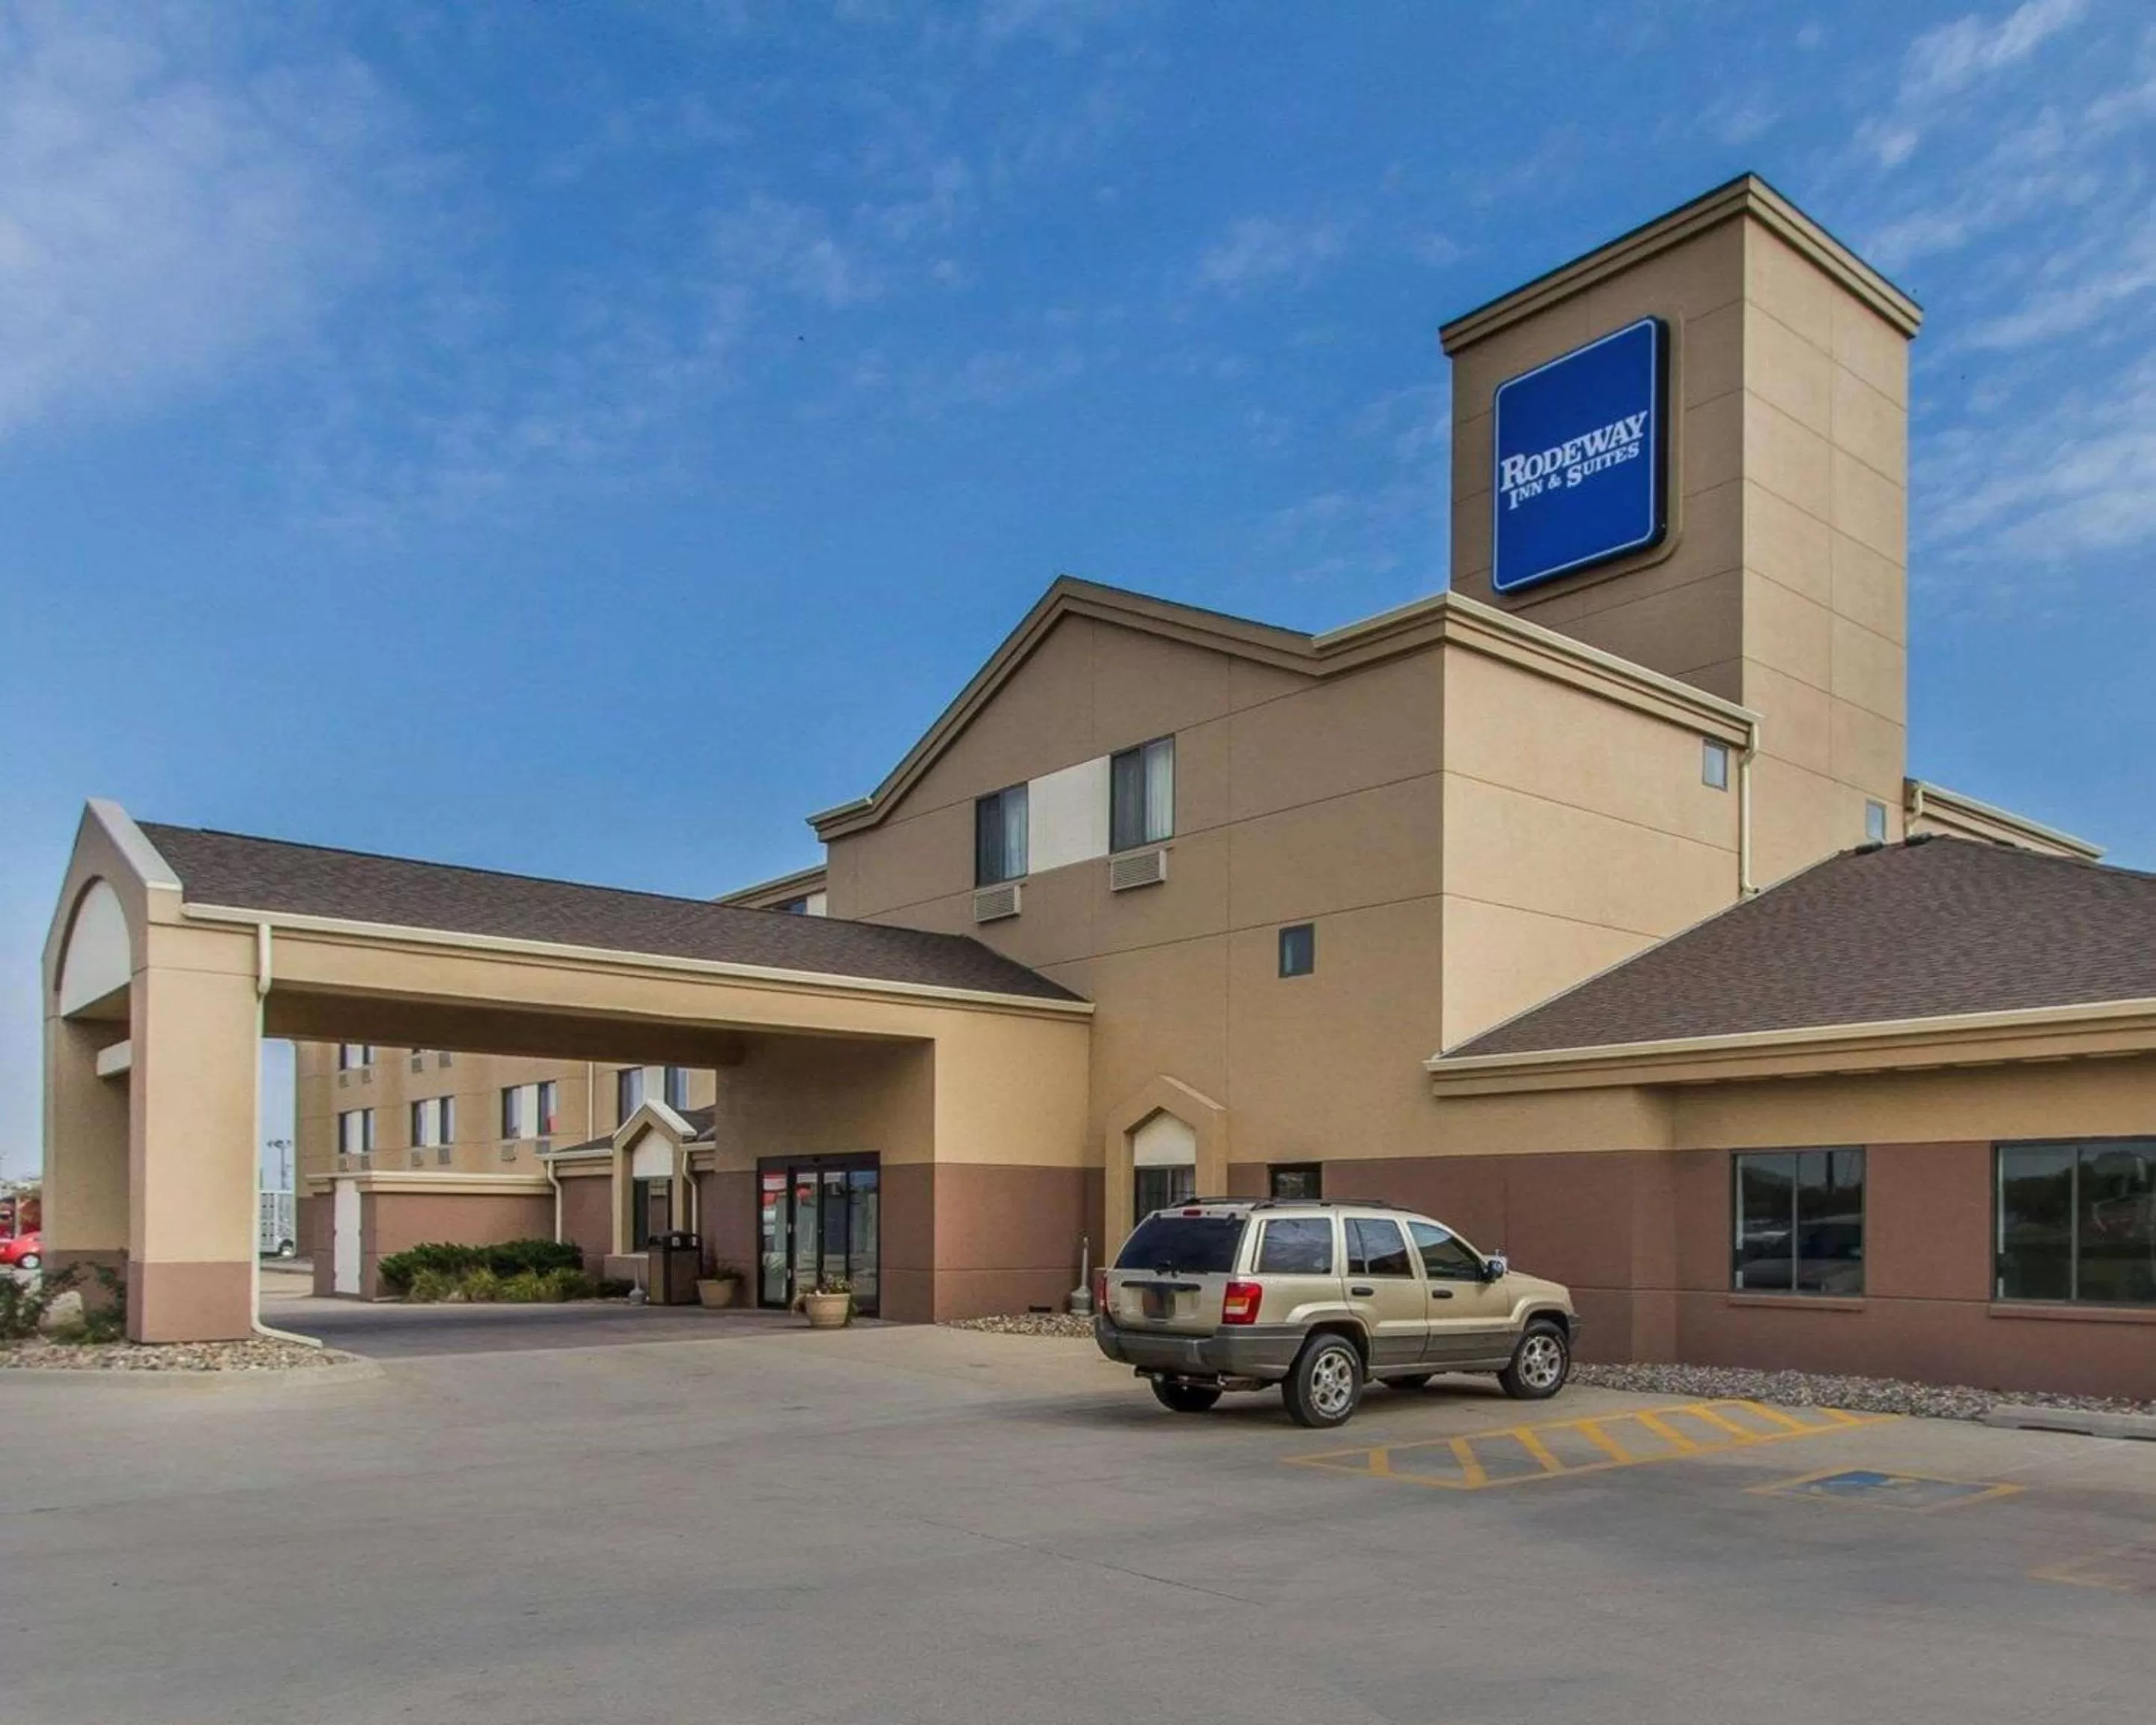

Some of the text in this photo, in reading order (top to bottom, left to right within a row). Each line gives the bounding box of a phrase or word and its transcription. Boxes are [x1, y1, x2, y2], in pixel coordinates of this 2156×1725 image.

[1500, 410, 1648, 493] RODEWAY
[1508, 442, 1639, 510] INN & SUITES
